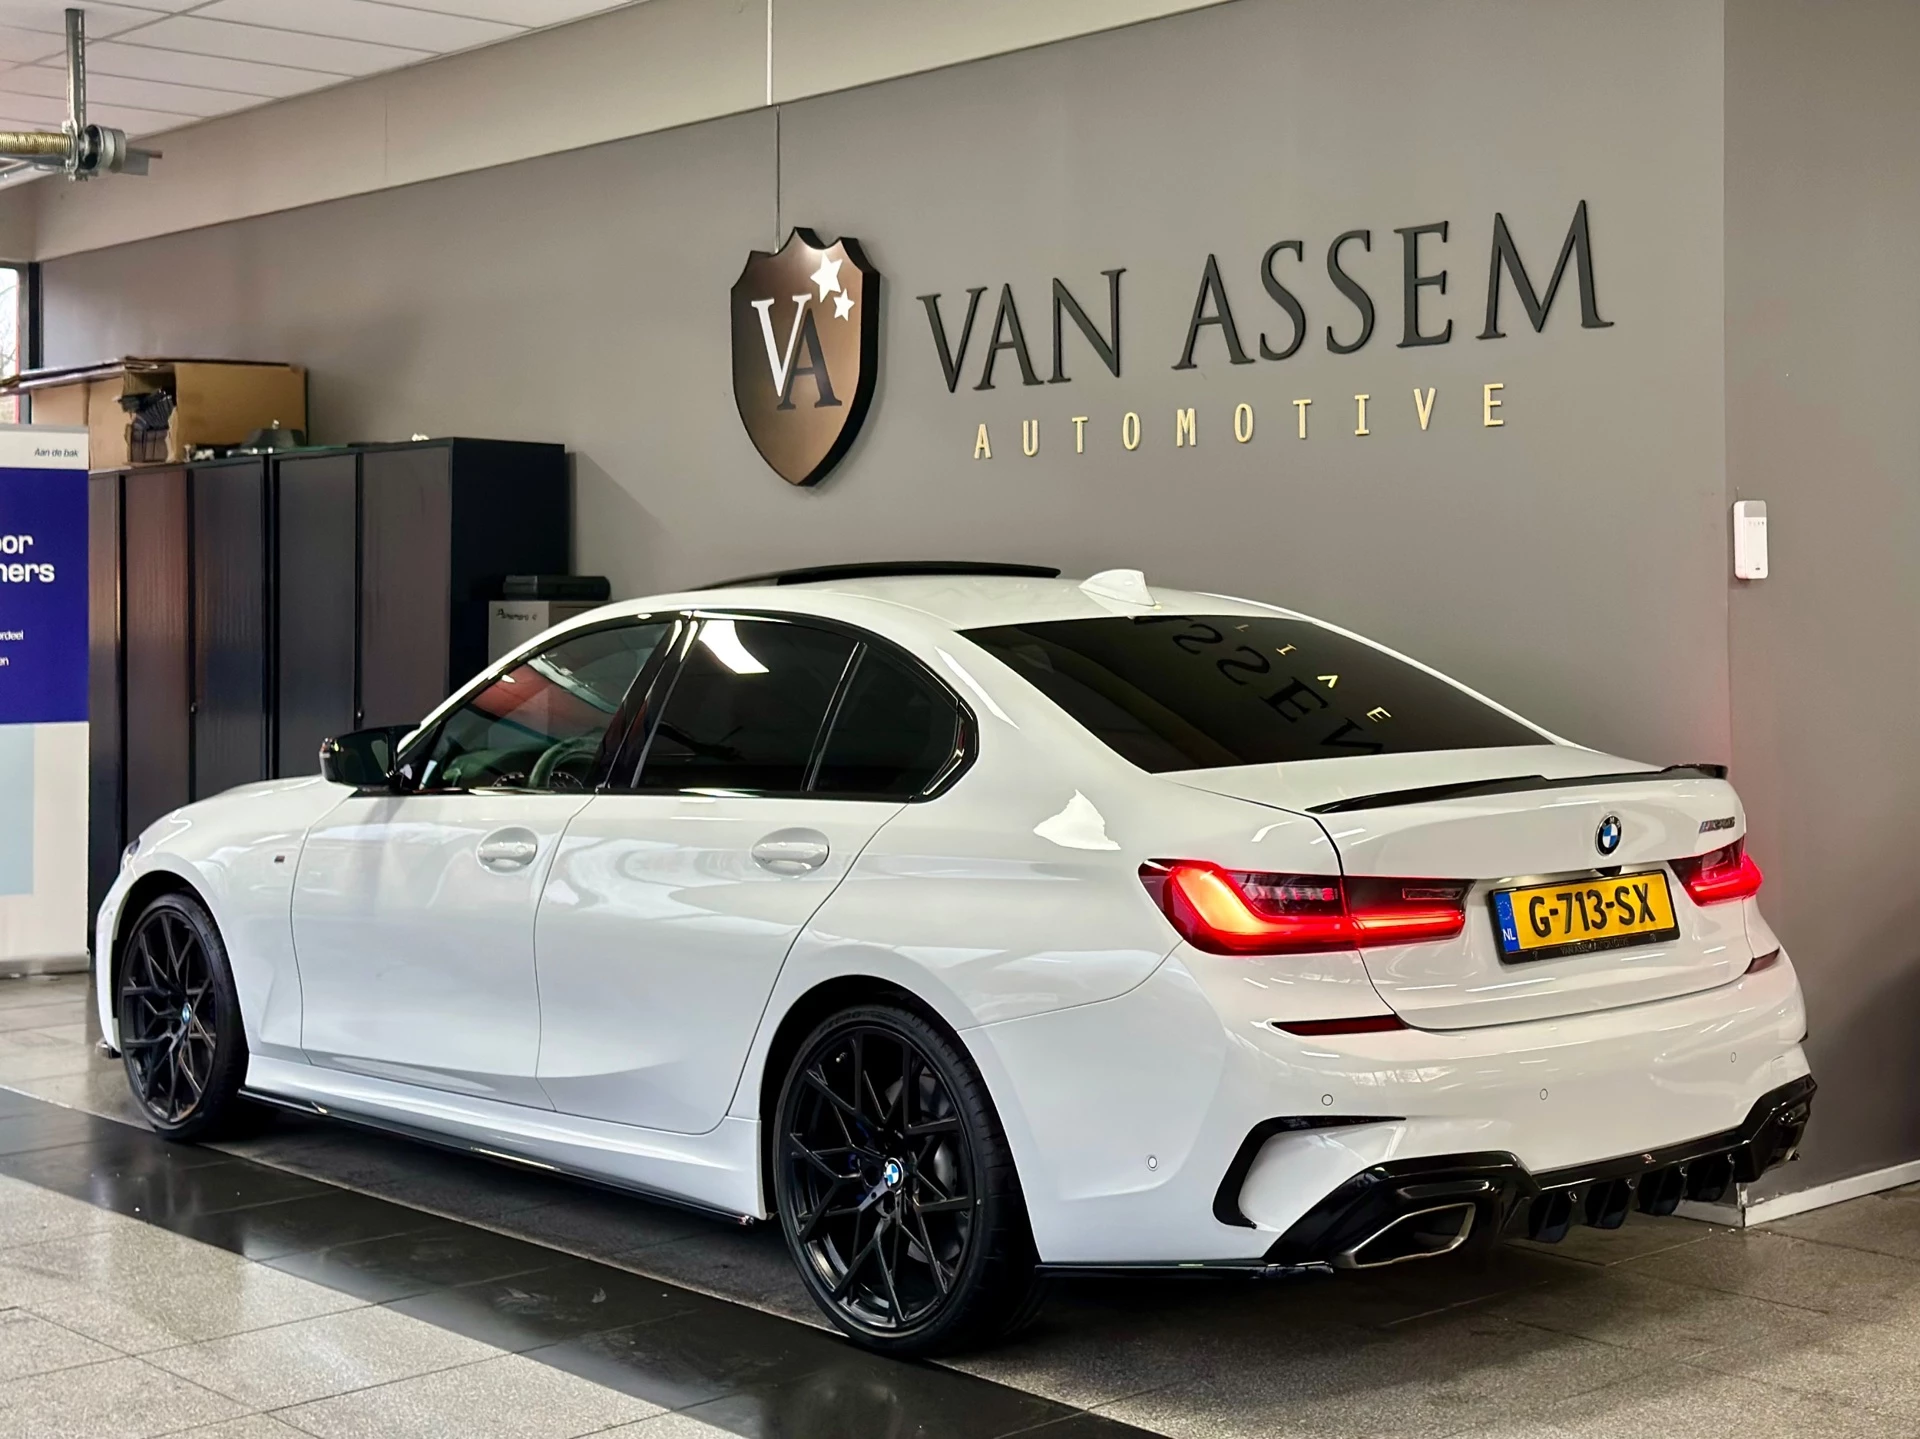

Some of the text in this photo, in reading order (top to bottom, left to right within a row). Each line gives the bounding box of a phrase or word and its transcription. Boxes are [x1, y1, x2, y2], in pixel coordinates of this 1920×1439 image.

[916, 199, 1615, 394] VAN ASSEM
[751, 293, 843, 411] VA
[973, 383, 1505, 460] AUTOMOTIVE
[34, 447, 80, 458] Aan de bak
[0, 534, 33, 554] or
[1502, 927, 1517, 942] NL
[1529, 882, 1657, 938] G-713-SX
